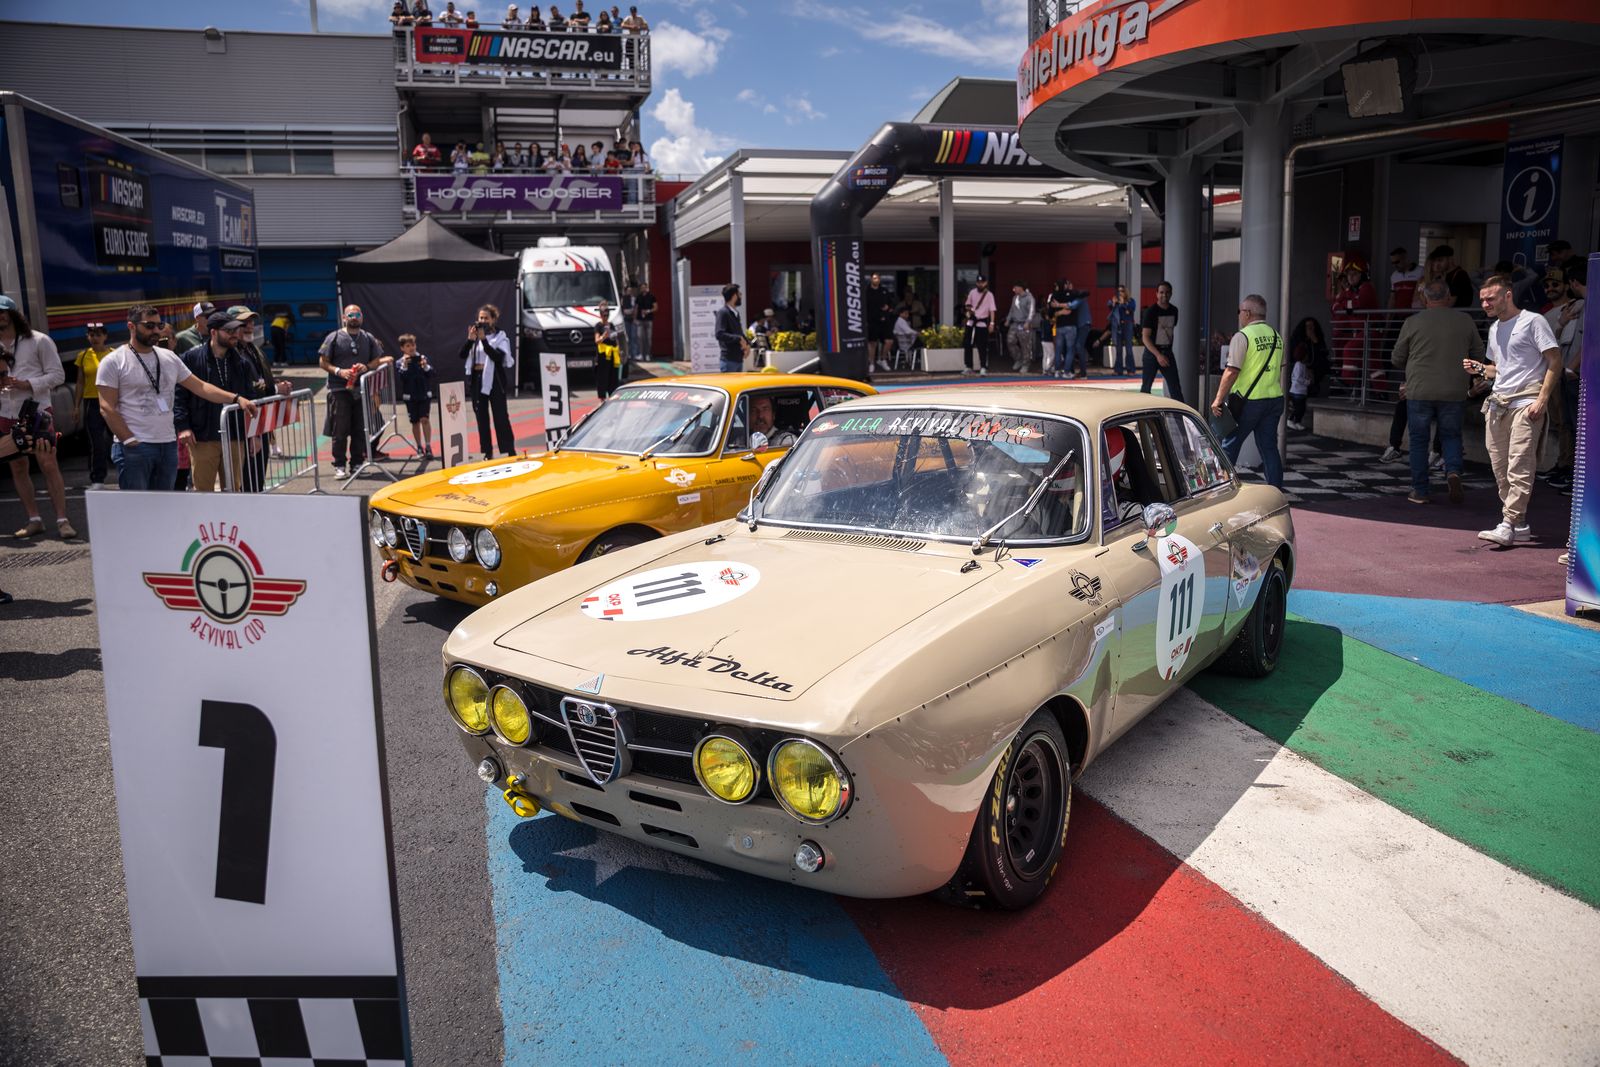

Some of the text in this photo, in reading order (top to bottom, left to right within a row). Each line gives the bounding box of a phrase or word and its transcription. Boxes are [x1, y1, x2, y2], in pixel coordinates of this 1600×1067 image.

[500, 36, 614, 63] NASCAR.eu
[980, 131, 1043, 166] NA
[111, 176, 144, 209] NASCAR
[427, 187, 612, 199] HOOSIER HOOSIER
[103, 227, 150, 257] EURO SERIES
[1505, 228, 1551, 240] INFO POINT
[845, 241, 863, 333] NASCAR.eu
[549, 384, 563, 416] 3
[841, 417, 883, 431] ALFA
[888, 417, 959, 433] REVIVAL
[450, 432, 463, 468] 2
[199, 521, 239, 545] ALFA
[633, 572, 706, 607] 111
[1169, 572, 1194, 642] 111
[190, 615, 266, 650] REVIVAL CUP
[1170, 642, 1184, 660] OKP
[626, 646, 795, 693] Alfa Delta
[198, 699, 277, 905] 1
[991, 825, 1000, 845] P
